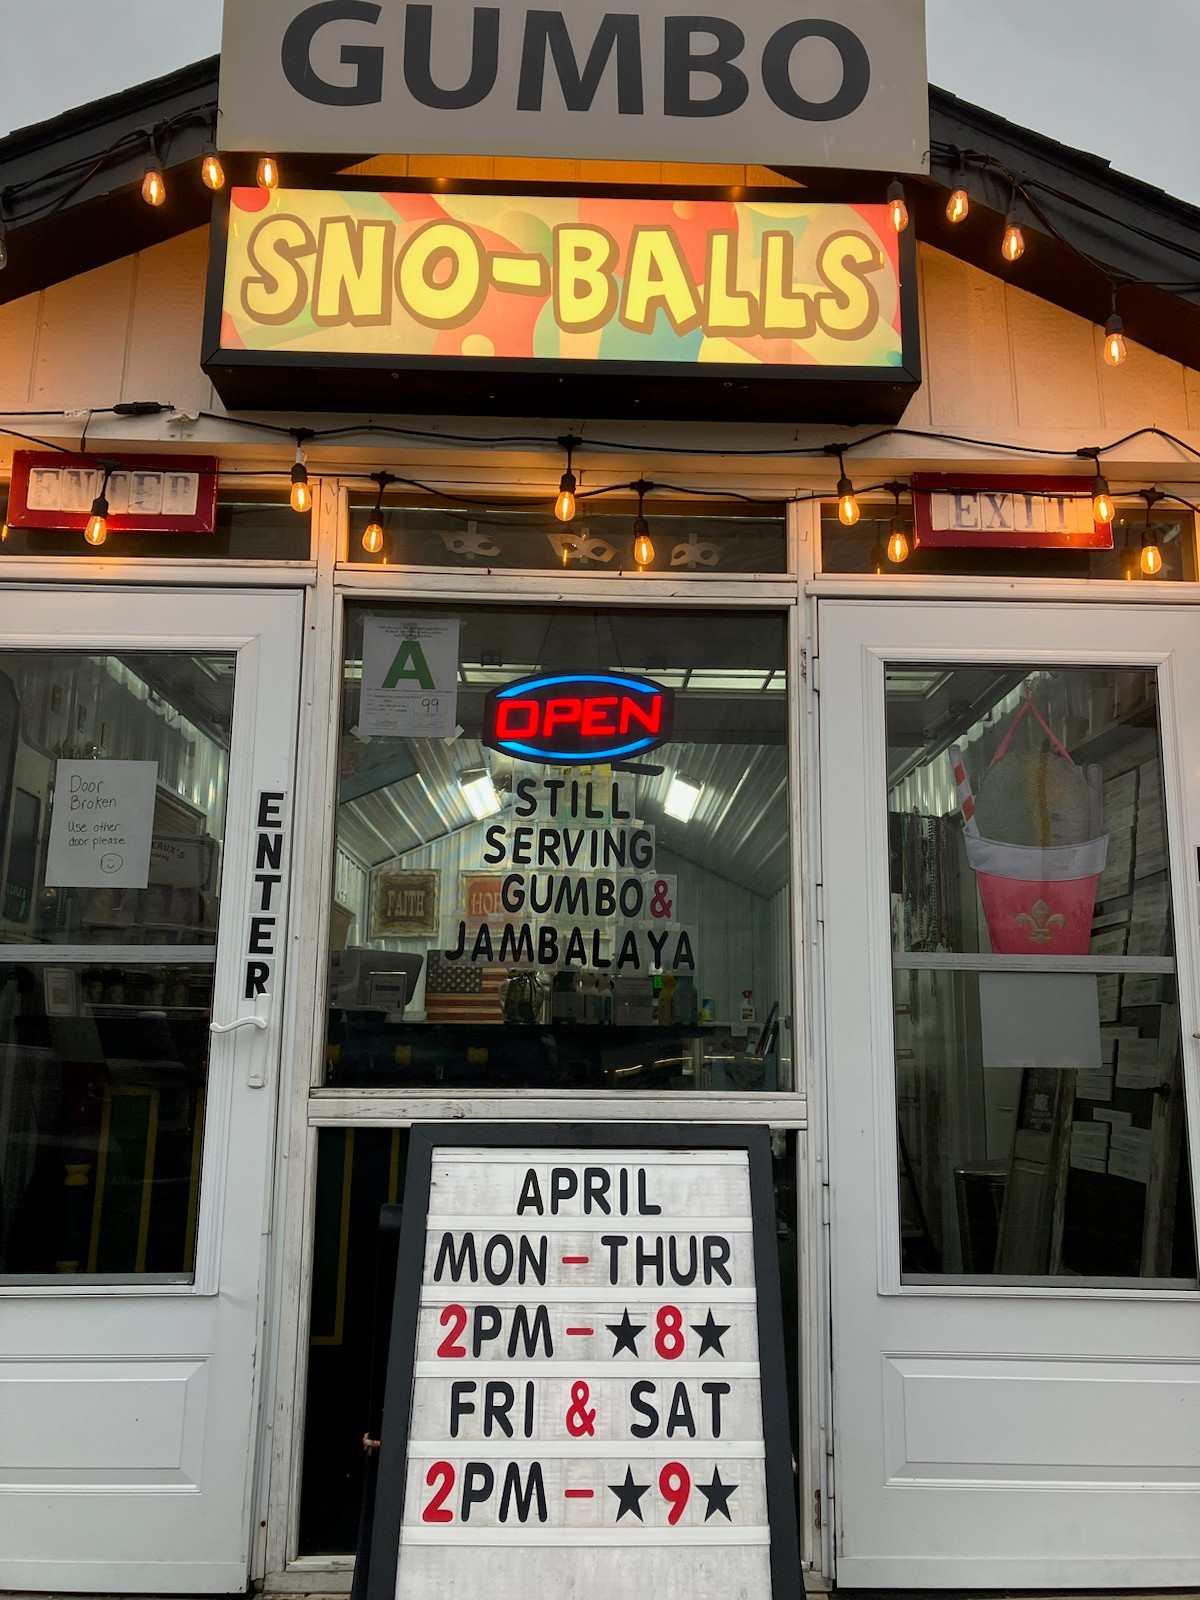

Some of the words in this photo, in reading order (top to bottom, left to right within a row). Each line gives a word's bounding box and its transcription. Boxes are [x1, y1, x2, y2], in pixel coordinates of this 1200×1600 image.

[281, 0, 871, 122] GUMBO
[241, 213, 882, 339] SNO-BALLS
[952, 494, 1073, 529] EXIT
[382, 640, 436, 690] A
[421, 698, 439, 713] 99
[495, 695, 662, 739] OPEN
[68, 775, 104, 794] Door
[70, 796, 117, 811] Broken
[515, 779, 631, 819] STILL
[67, 822, 87, 832] Use
[93, 822, 121, 832] other
[68, 836, 89, 847] door
[92, 836, 126, 850] please
[483, 825, 653, 869] SERVING
[245, 792, 284, 999] ENTER
[387, 890, 425, 917] FAITH
[445, 921, 695, 971] JAMBALAYA
[517, 1167, 662, 1216] APRIL
[433, 1232, 548, 1286] MON
[600, 1235, 732, 1286] THUR
[436, 1304, 554, 1359] 2PM
[450, 1381, 535, 1438] FRI
[565, 1380, 597, 1438] &
[630, 1380, 731, 1438] SAT
[422, 1460, 548, 1523] 2PM
